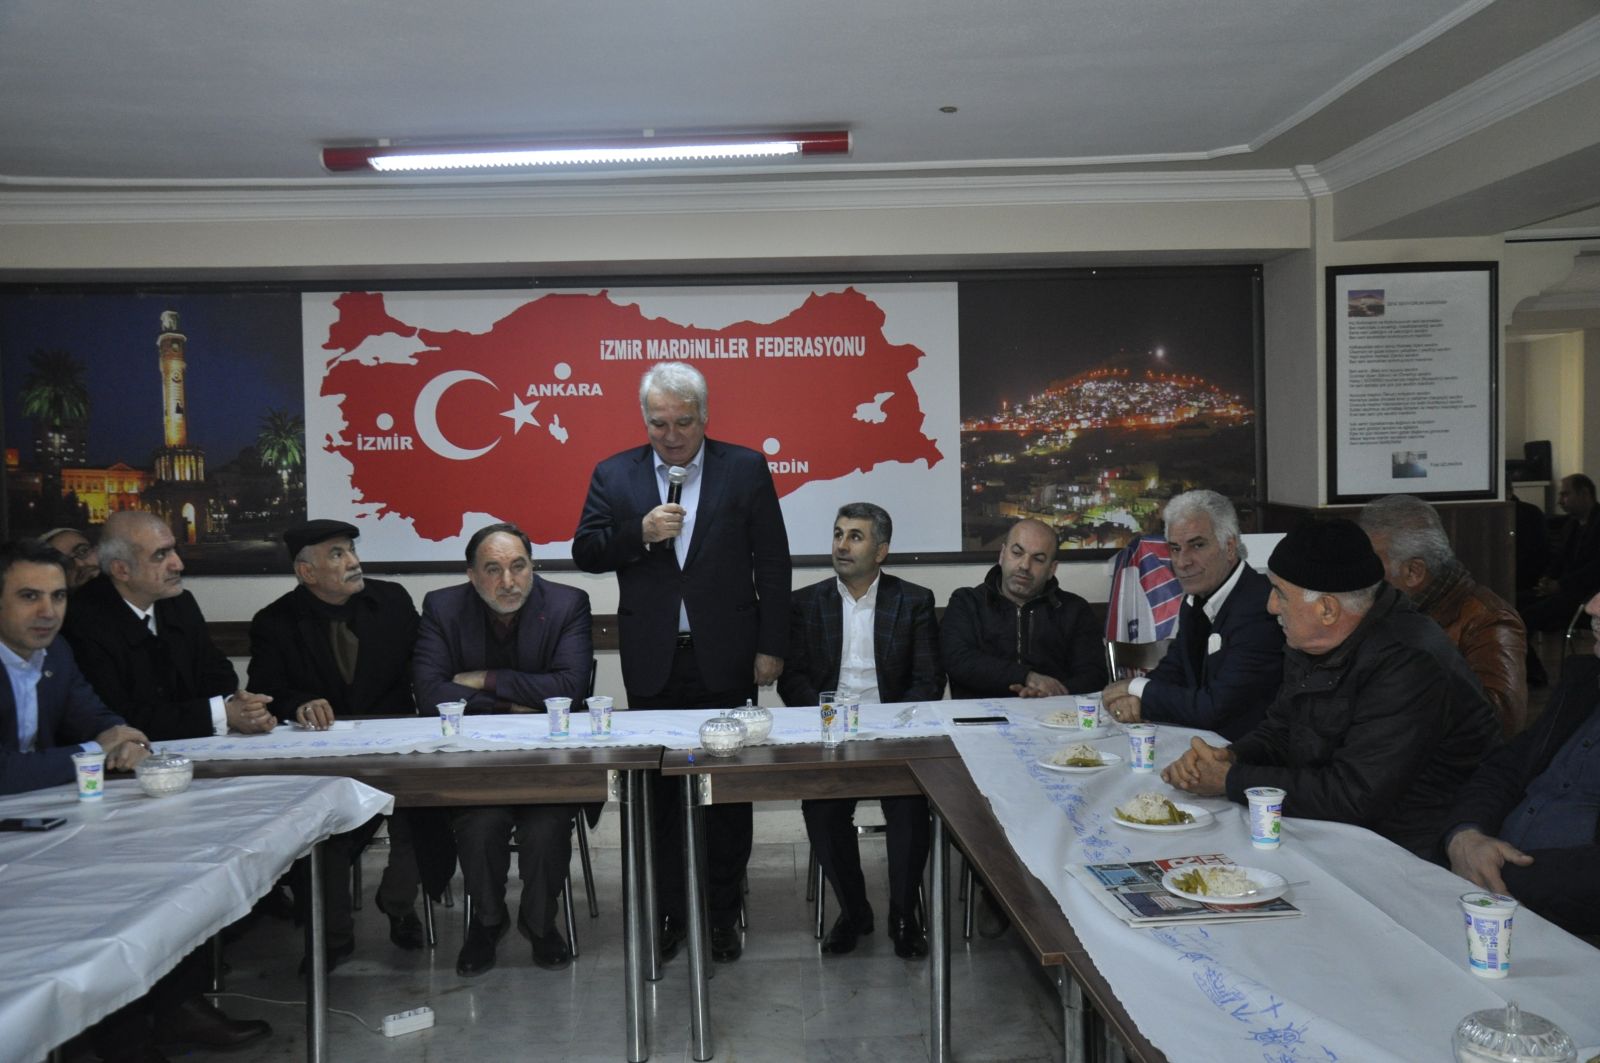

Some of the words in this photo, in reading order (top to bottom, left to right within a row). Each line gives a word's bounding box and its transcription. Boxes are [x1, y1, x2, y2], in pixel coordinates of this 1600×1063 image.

[755, 336, 866, 358] FEDERASYONU
[526, 383, 604, 397] ANKARA
[357, 433, 414, 451] İZMİR
[767, 459, 809, 474] RDİN
